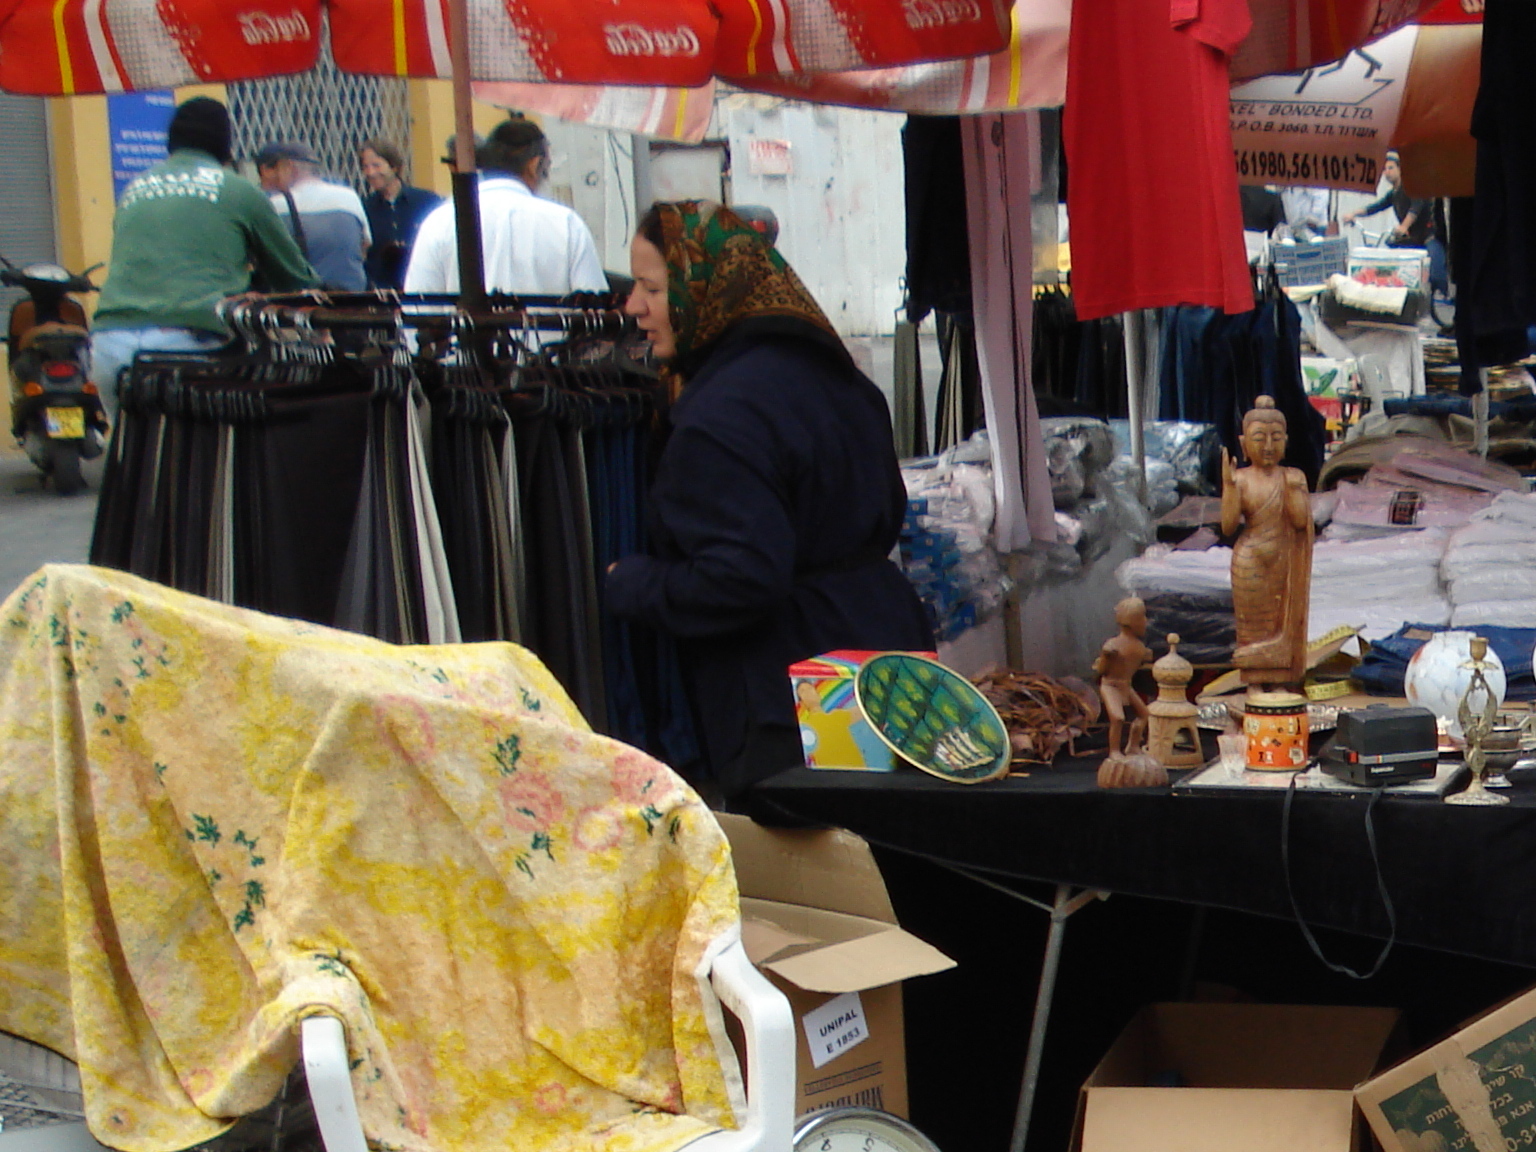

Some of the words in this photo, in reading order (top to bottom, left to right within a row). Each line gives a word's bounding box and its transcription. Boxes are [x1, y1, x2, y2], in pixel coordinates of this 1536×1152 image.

[1268, 105, 1337, 118] BONDED
[819, 1009, 858, 1037] UNIPAL
[826, 1042, 834, 1054] E
